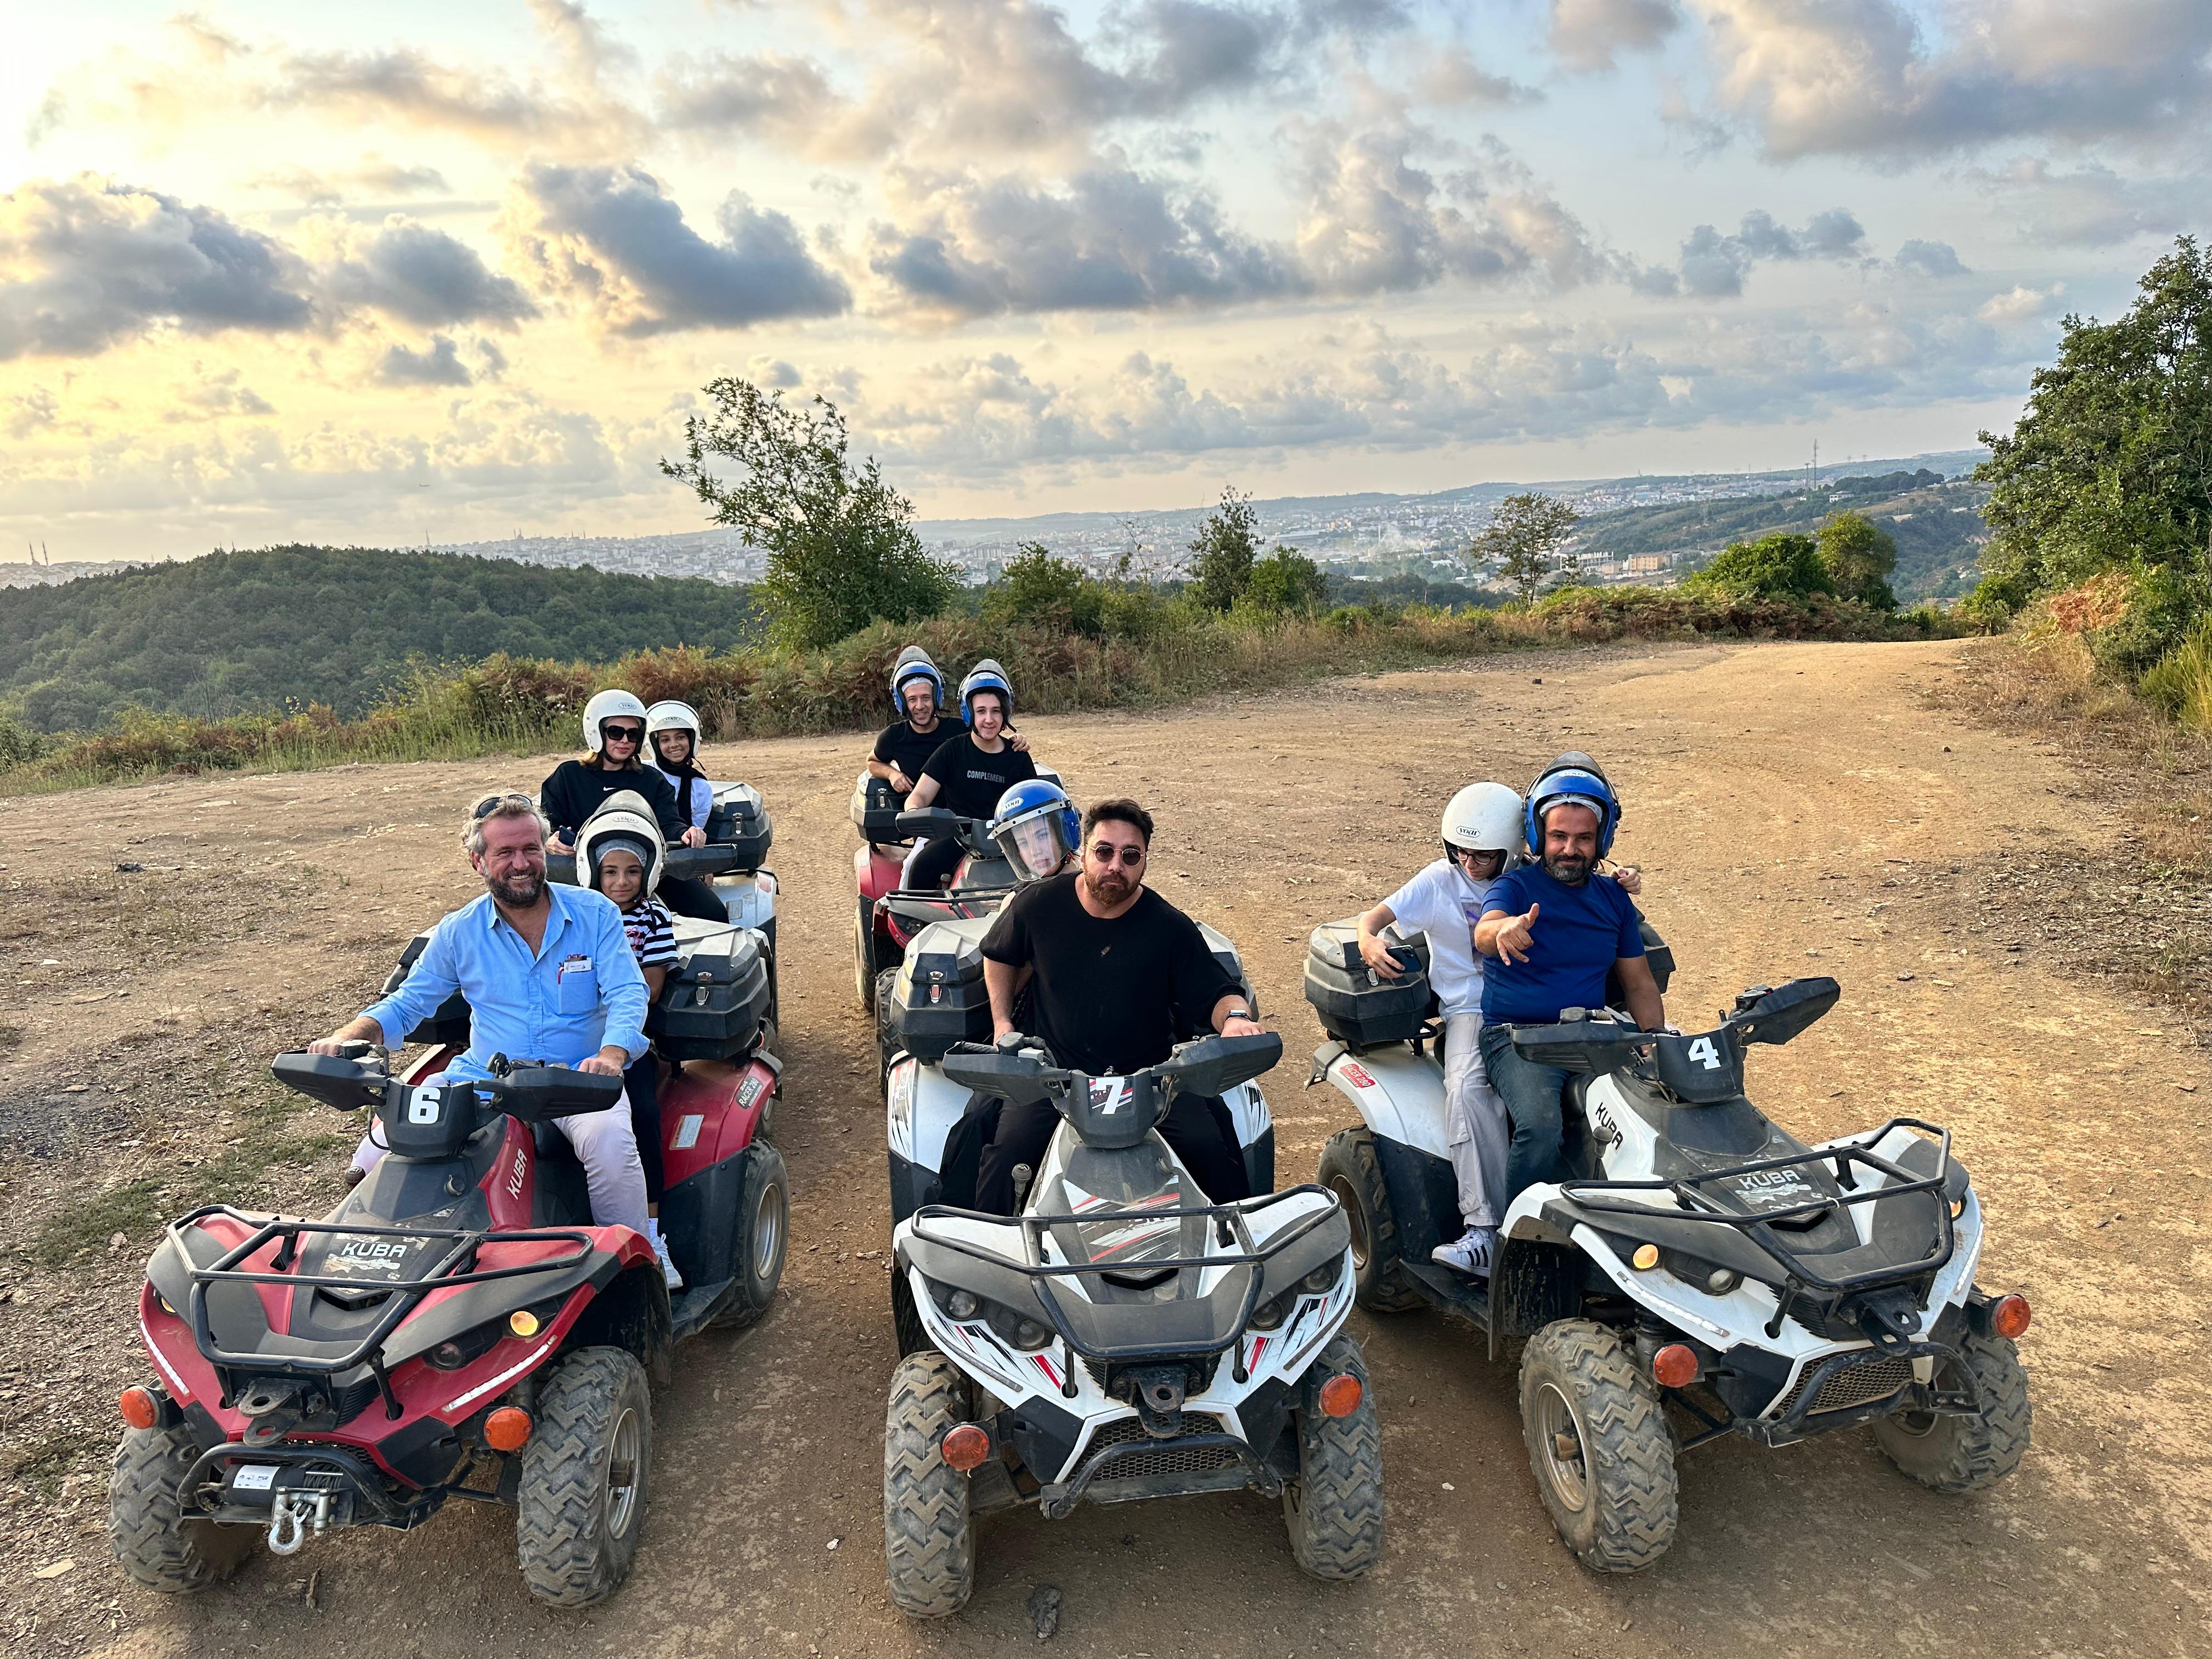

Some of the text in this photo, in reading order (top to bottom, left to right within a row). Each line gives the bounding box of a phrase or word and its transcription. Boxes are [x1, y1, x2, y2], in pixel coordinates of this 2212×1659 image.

[1688, 1036, 1722, 1070] 4
[408, 1087, 441, 1125] 6
[738, 1086, 754, 1107] RACER
[1096, 1077, 1125, 1115] 7
[507, 1148, 527, 1200] KUBA
[1738, 1170, 1801, 1189] KUBA
[341, 1243, 407, 1257] KUBA
